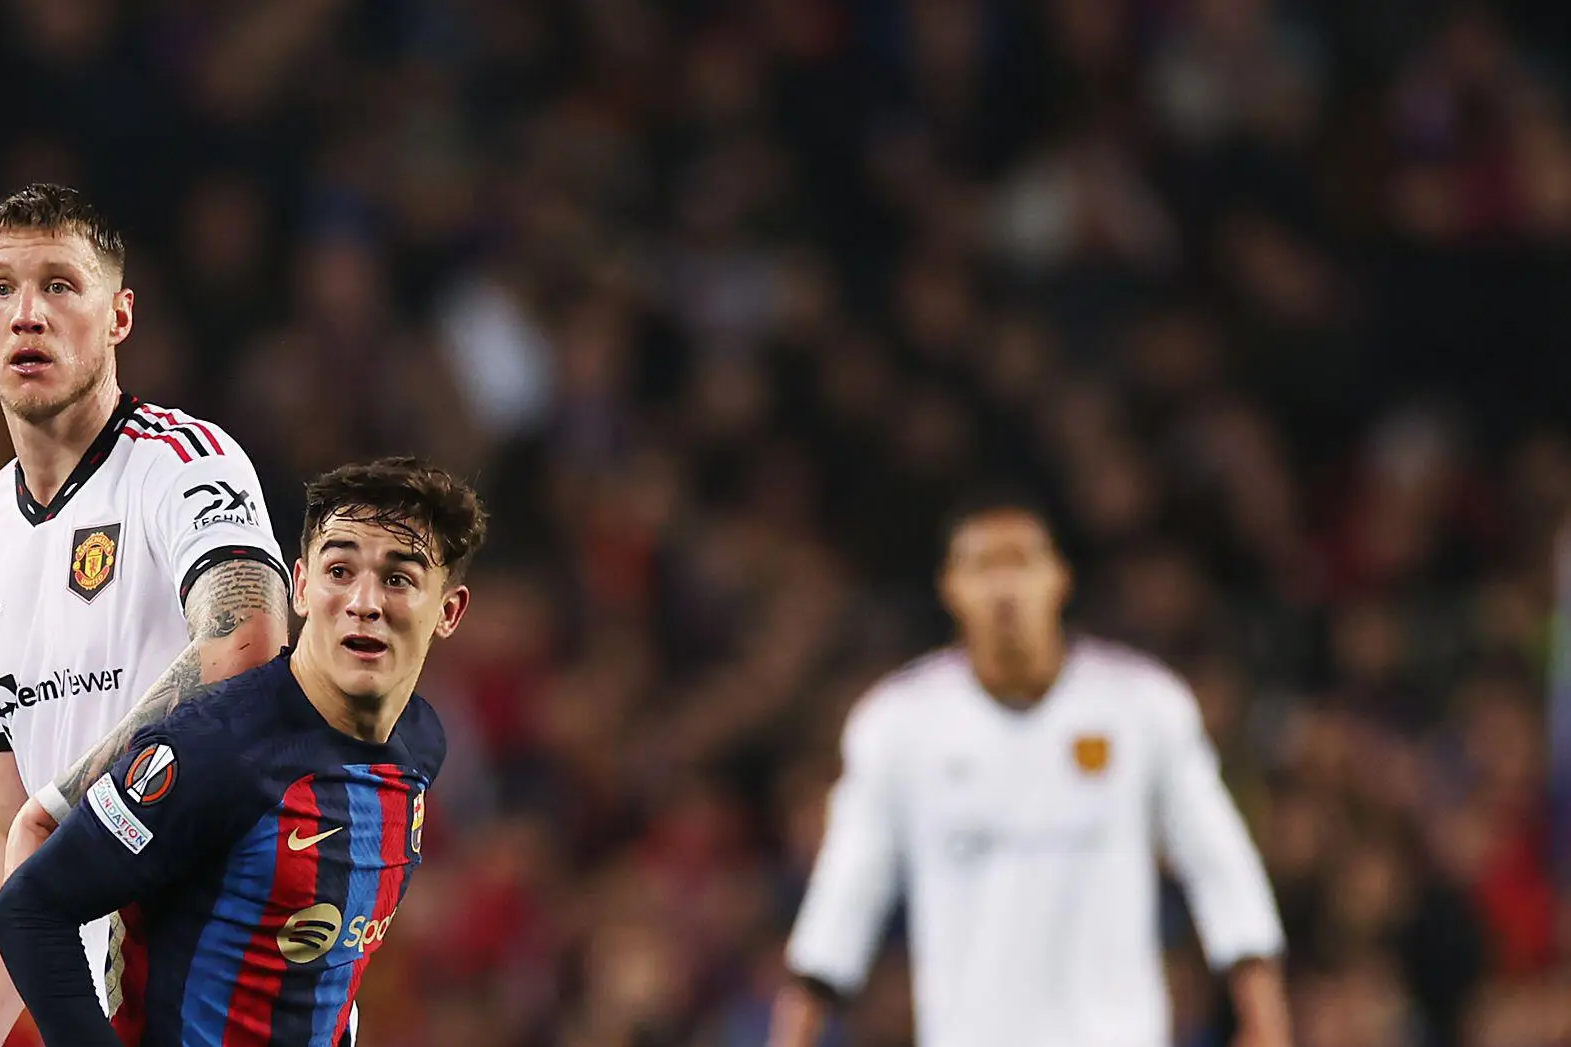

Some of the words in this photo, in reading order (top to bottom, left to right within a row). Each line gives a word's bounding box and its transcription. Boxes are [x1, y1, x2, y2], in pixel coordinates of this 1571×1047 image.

[183, 481, 256, 520] DX
[17, 668, 123, 708] emViewer
[343, 907, 397, 952] Spo
